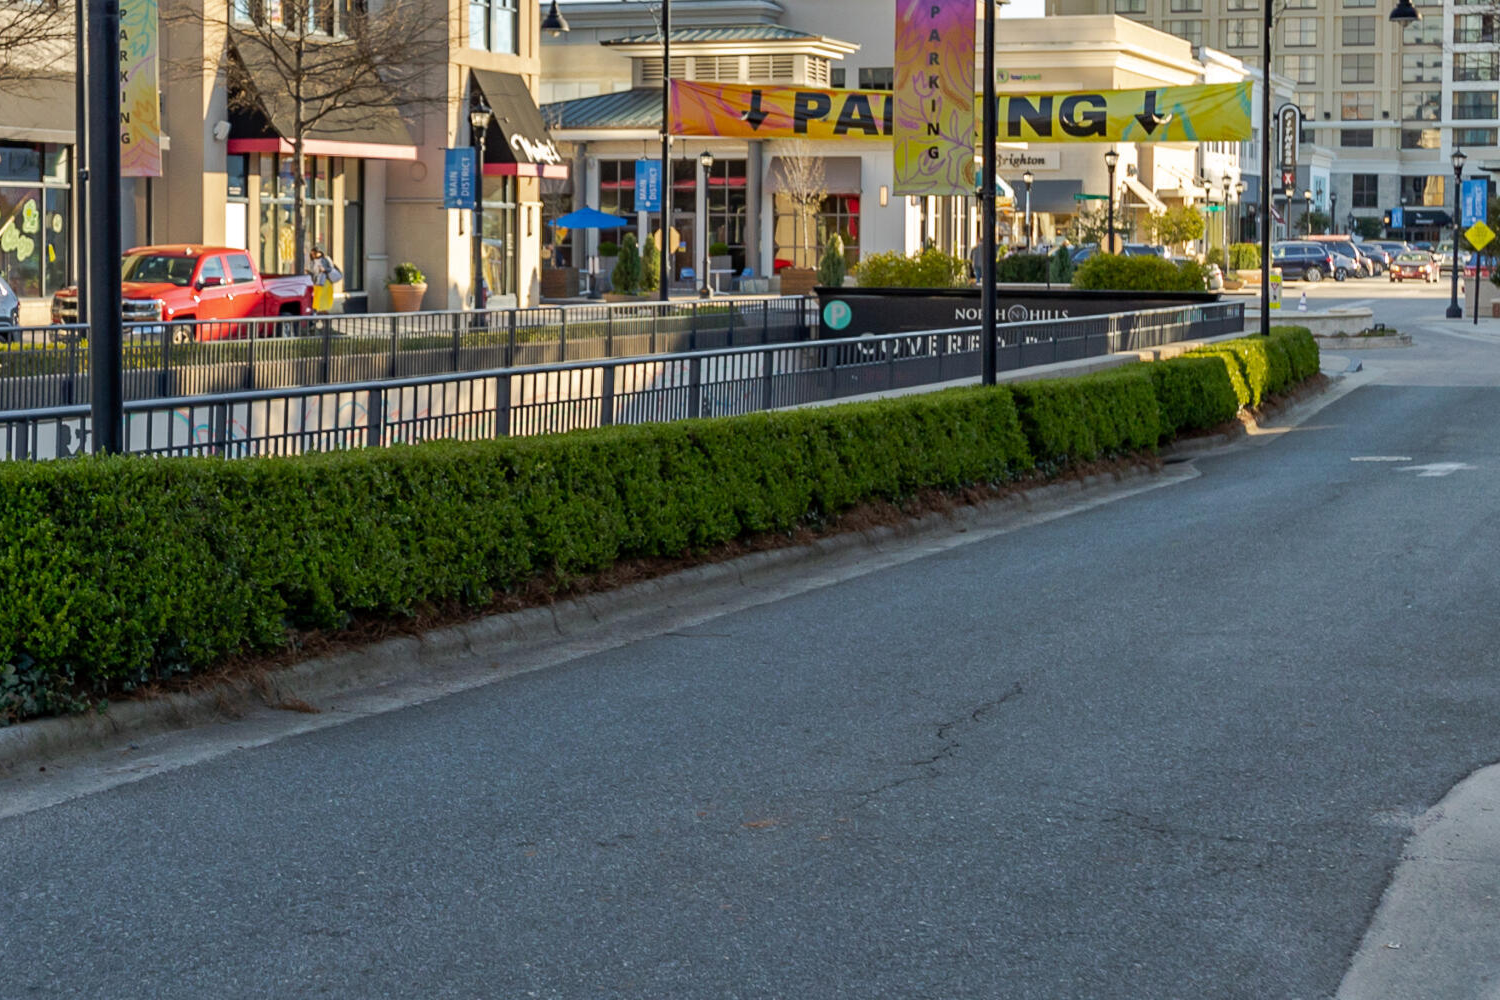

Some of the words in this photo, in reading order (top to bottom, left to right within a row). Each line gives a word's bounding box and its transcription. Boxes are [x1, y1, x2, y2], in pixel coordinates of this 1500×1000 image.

[119, 8, 131, 145] PARKING
[926, 5, 941, 160] PARKING
[793, 90, 1107, 138] PANG
[449, 170, 458, 196] MAIN
[461, 156, 471, 197] DISTRICT
[955, 308, 1006, 321] NOH
